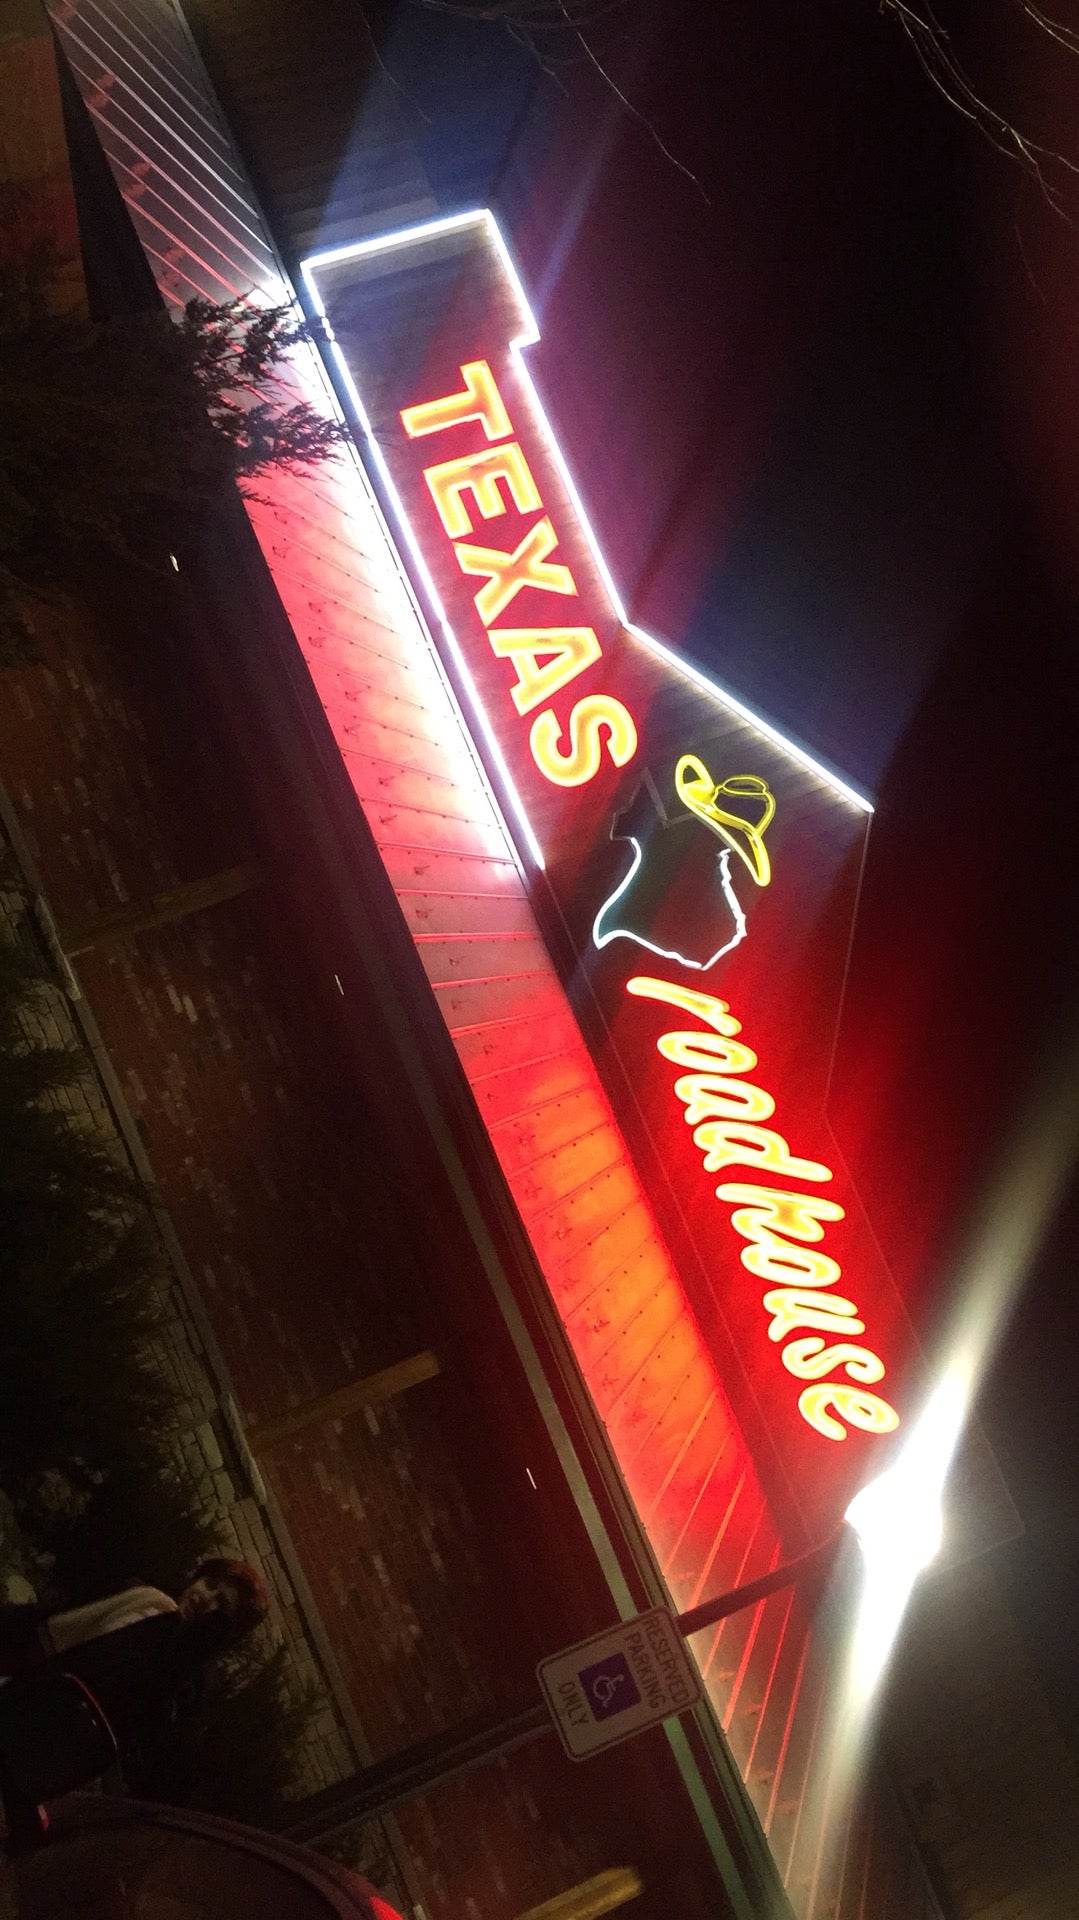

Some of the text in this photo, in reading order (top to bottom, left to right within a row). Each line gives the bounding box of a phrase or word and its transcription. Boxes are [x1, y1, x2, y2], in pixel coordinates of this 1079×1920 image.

[400, 359, 900, 1441] TEXAS roadhouse
[624, 1632, 666, 1709] PARKING
[645, 1616, 689, 1703] RESERVED
[558, 1681, 589, 1727] ONLY
